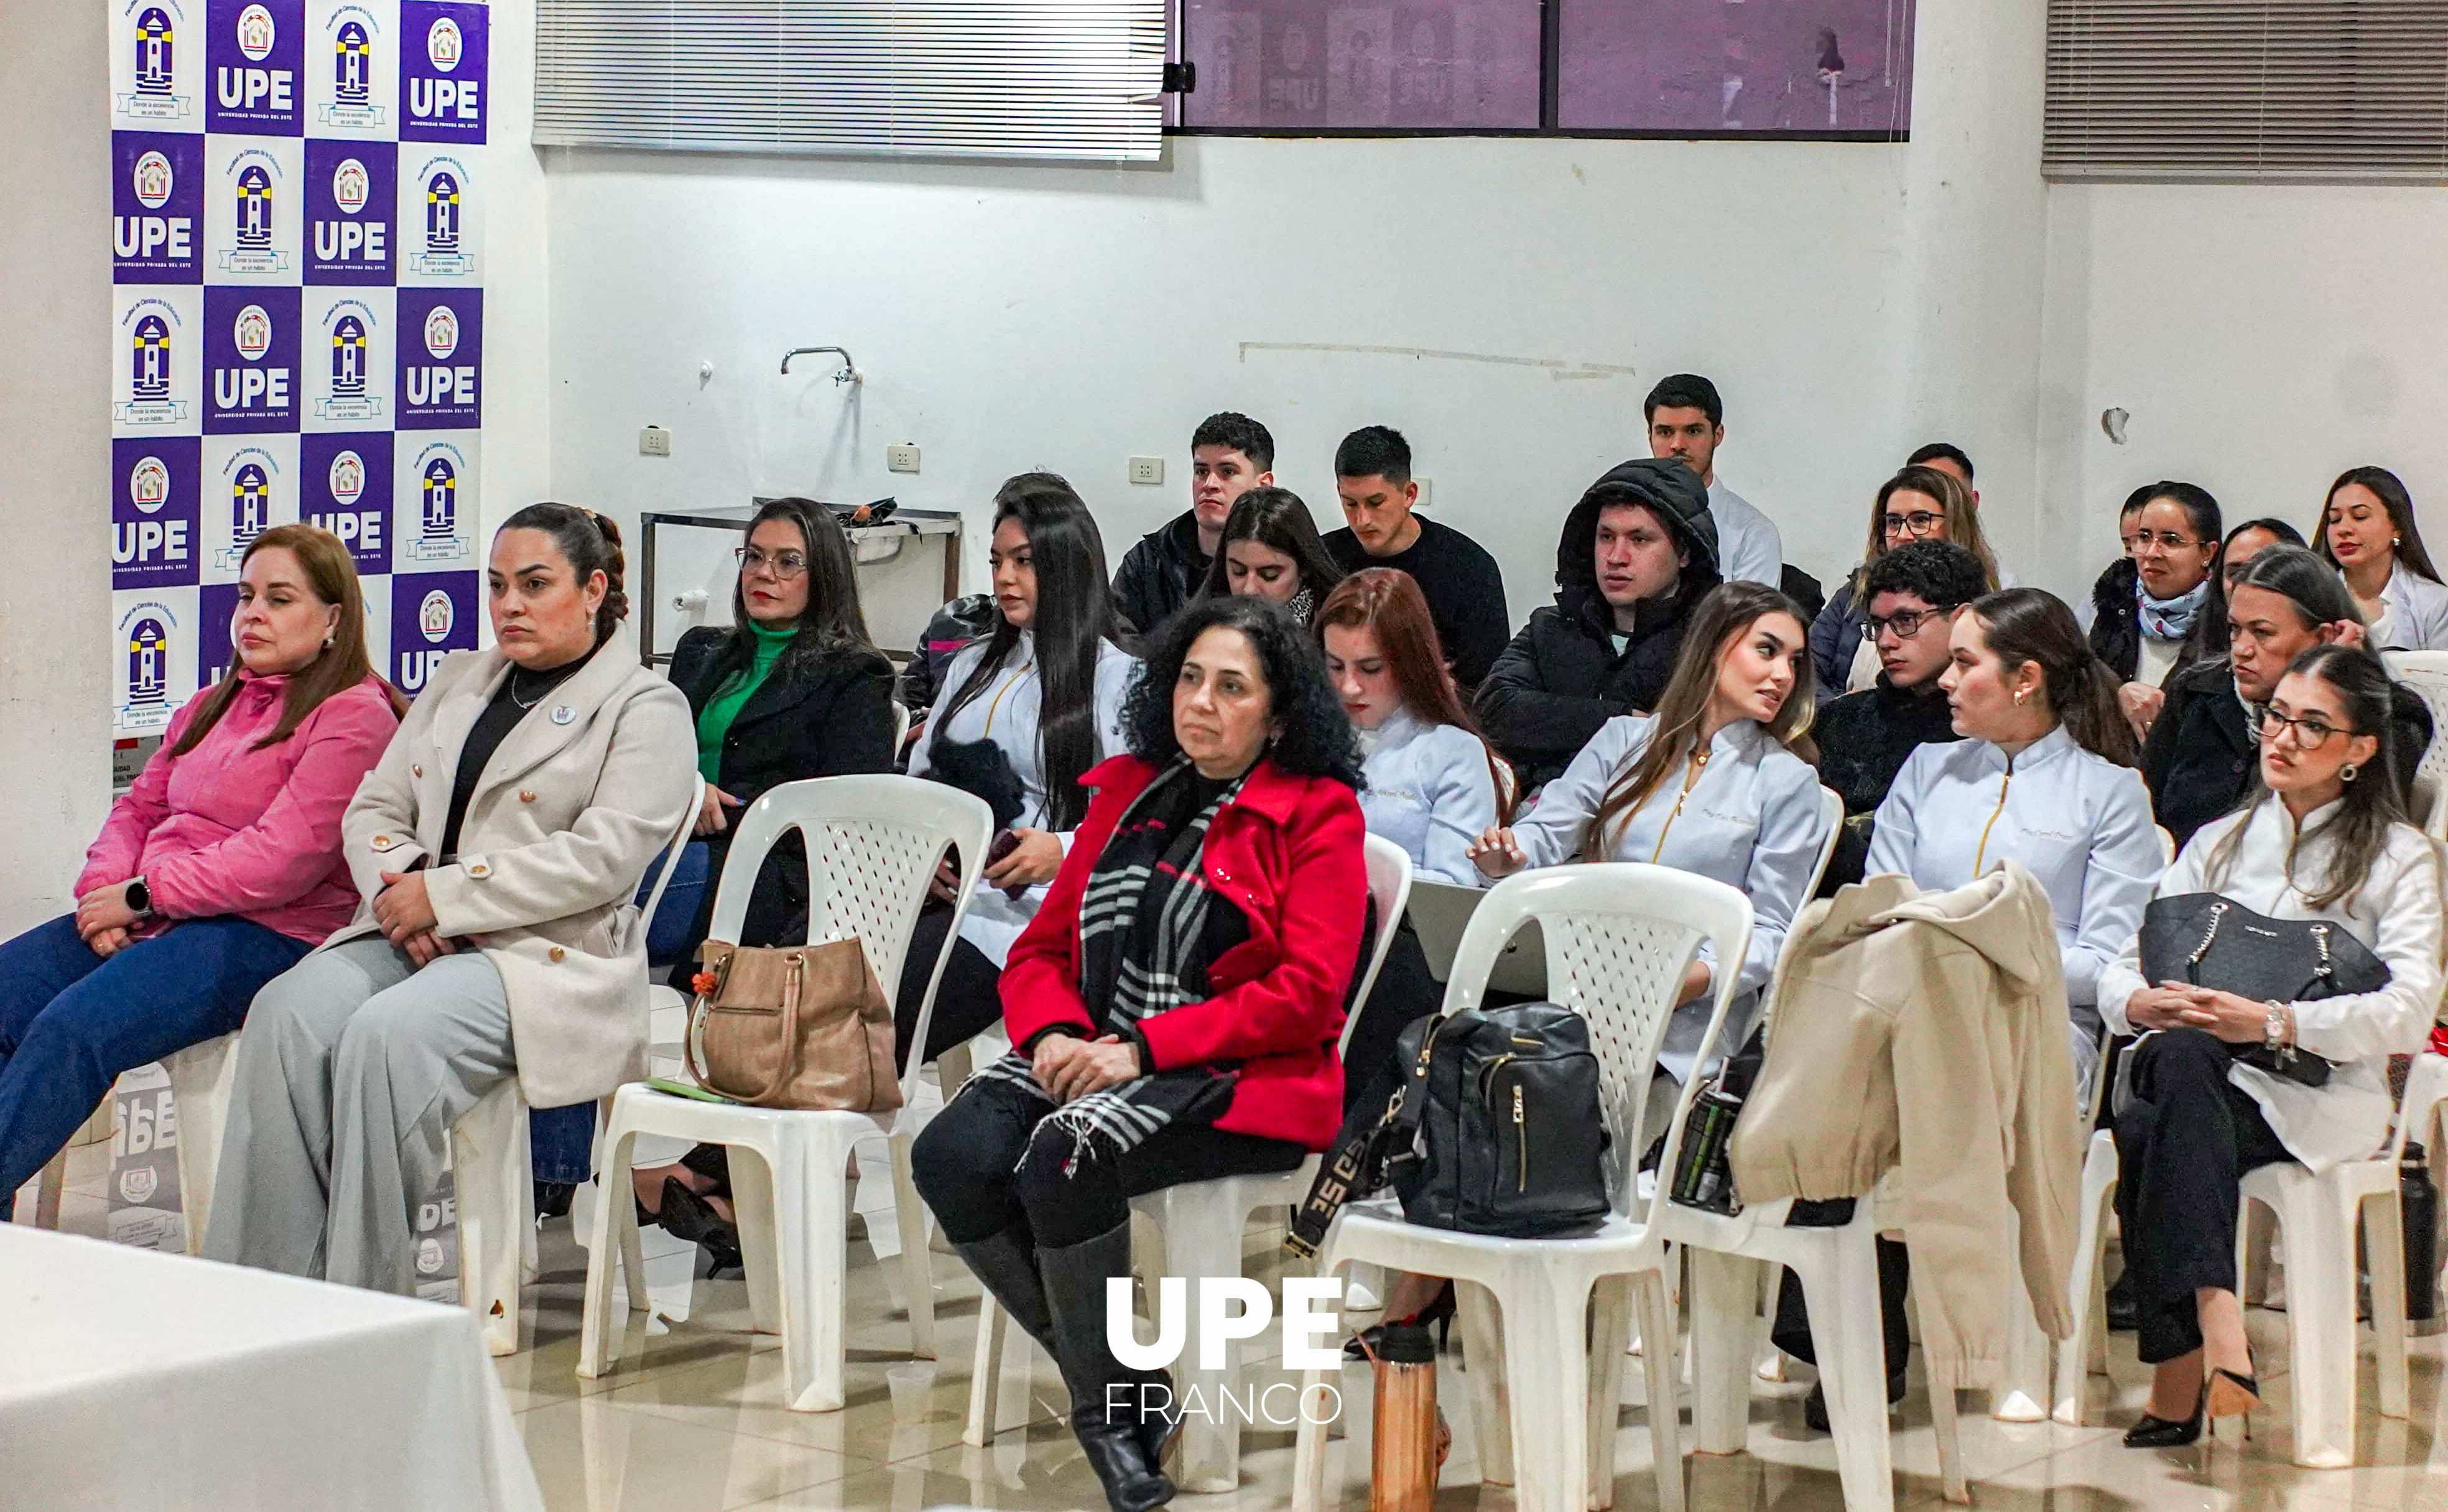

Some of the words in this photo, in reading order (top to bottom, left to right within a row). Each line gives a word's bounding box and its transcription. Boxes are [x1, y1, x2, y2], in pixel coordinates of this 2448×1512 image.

[218, 67, 292, 110] UPE
[410, 78, 478, 119] UPE
[114, 216, 191, 257] UPE
[315, 221, 386, 261] UPE
[215, 368, 289, 409] UPE
[407, 366, 475, 406] UPE
[112, 520, 188, 564] UPE
[402, 648, 469, 690] UP
